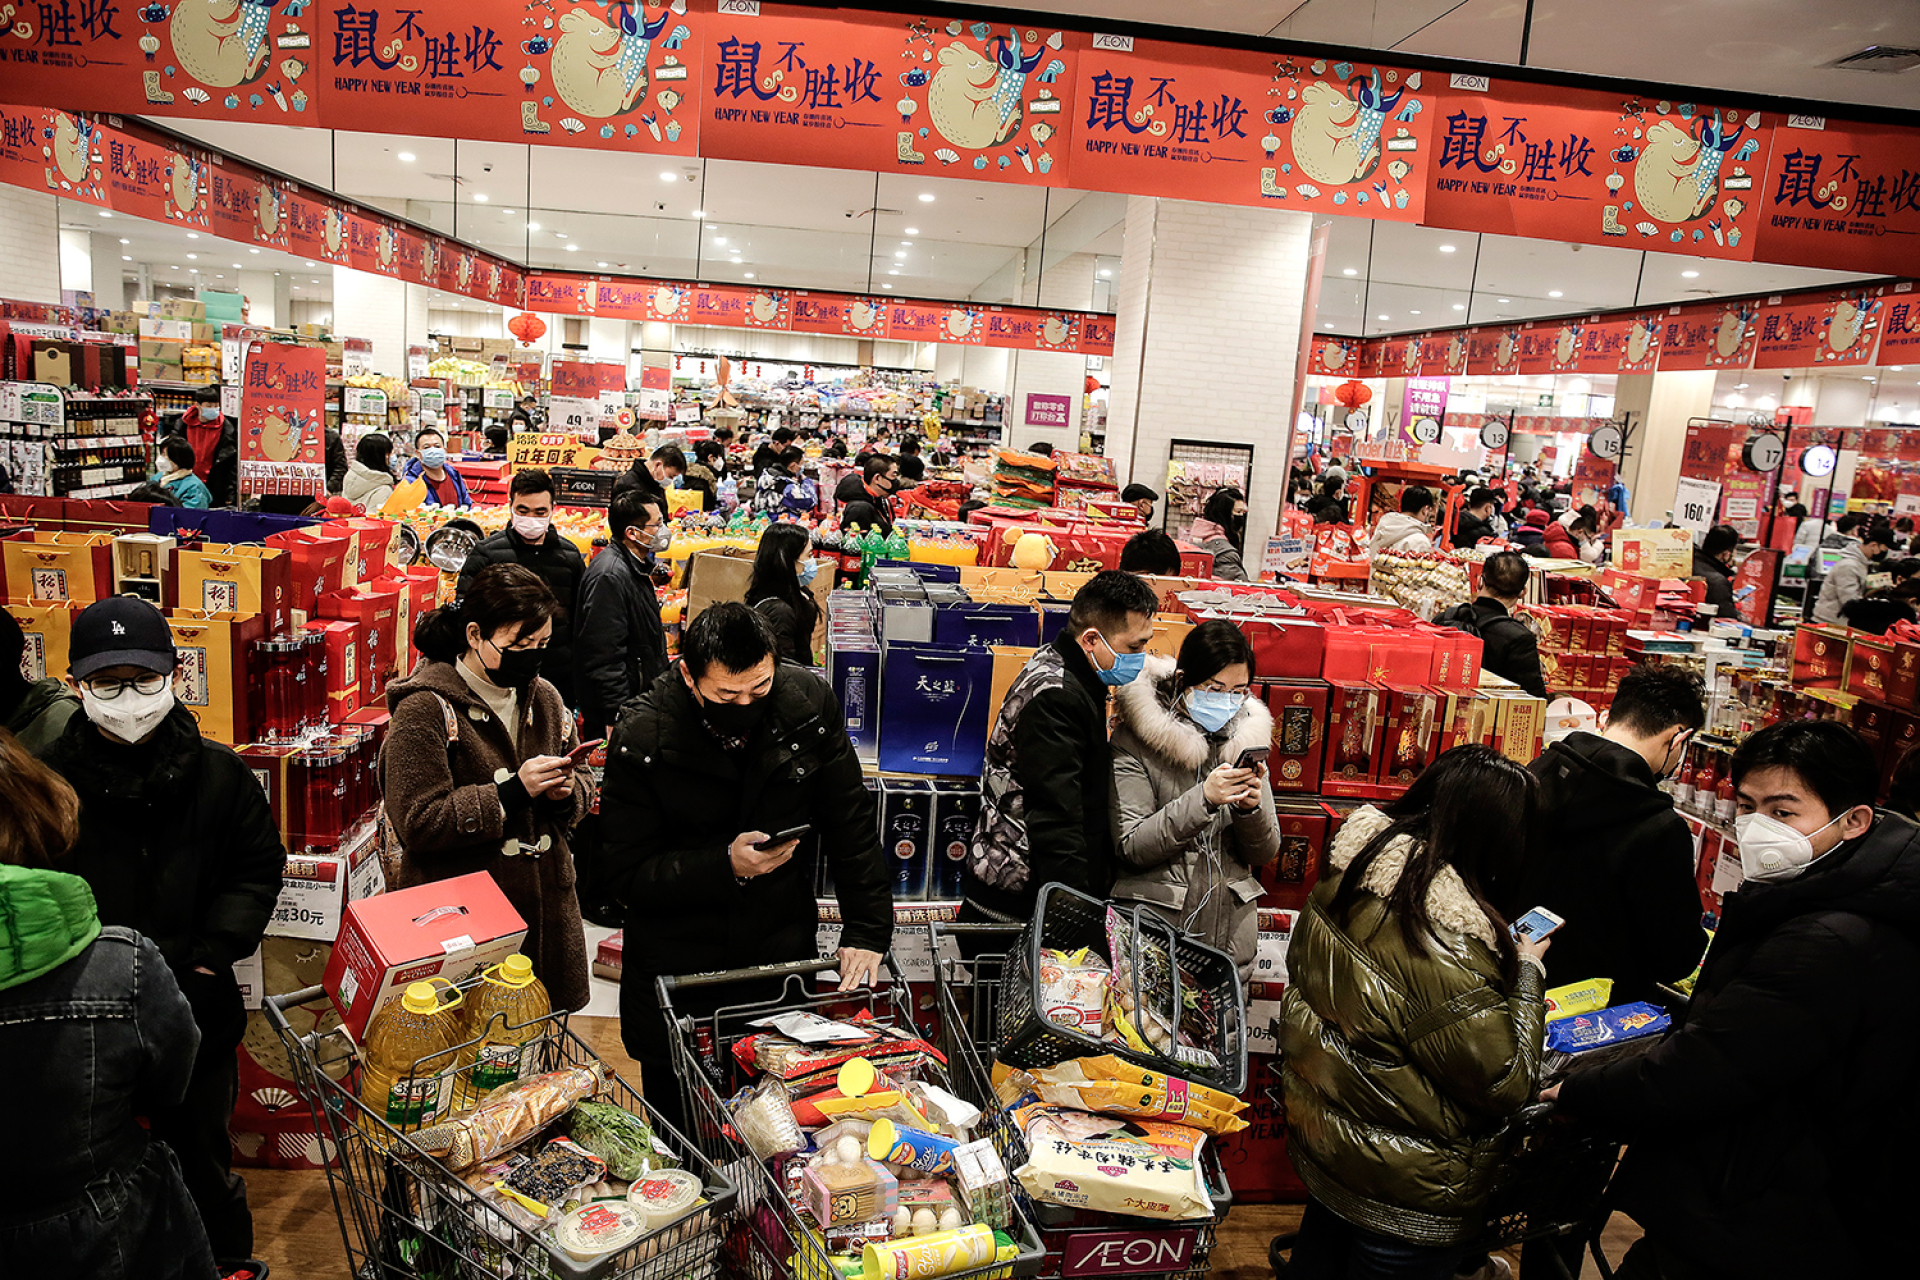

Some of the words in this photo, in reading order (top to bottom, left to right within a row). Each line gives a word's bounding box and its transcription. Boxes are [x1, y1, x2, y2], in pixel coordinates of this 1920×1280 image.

[332, 3, 504, 79] 鼠不胜收
[12, 49, 39, 63] YEAR
[714, 35, 883, 110] 鼠不胜收
[334, 77, 368, 93] HAPPY
[371, 79, 392, 94] NEW
[395, 81, 421, 96] YEAR
[1086, 69, 1249, 144] 鼠不胜收
[714, 107, 748, 123] HAPPY
[750, 109, 770, 124] NEW
[773, 111, 800, 126] YEAR
[1086, 139, 1118, 155] HAPPY
[1121, 143, 1140, 157] NEW
[1143, 144, 1169, 159] YEAR
[1438, 109, 1596, 183] 鼠不胜收
[1436, 177, 1468, 194] HAPPY
[1471, 181, 1490, 195] NEW
[1493, 183, 1518, 198] YEAR
[1773, 147, 1920, 219] 鼠不胜收
[1771, 214, 1801, 230] HAPPY
[1802, 217, 1822, 231] NEW
[1823, 218, 1847, 233] YEAR
[250, 360, 319, 393] 鼠不胜收
[1355, 418, 1365, 427] 11
[1424, 428, 1436, 438] 12
[1492, 433, 1505, 444] 13
[1604, 439, 1619, 453] 15
[515, 448, 577, 465] 过年回家
[1765, 449, 1781, 464] 17
[110, 620, 126, 635] LA
[914, 674, 957, 694] 天之蓝
[1251, 1123, 1286, 1140] YEAR
